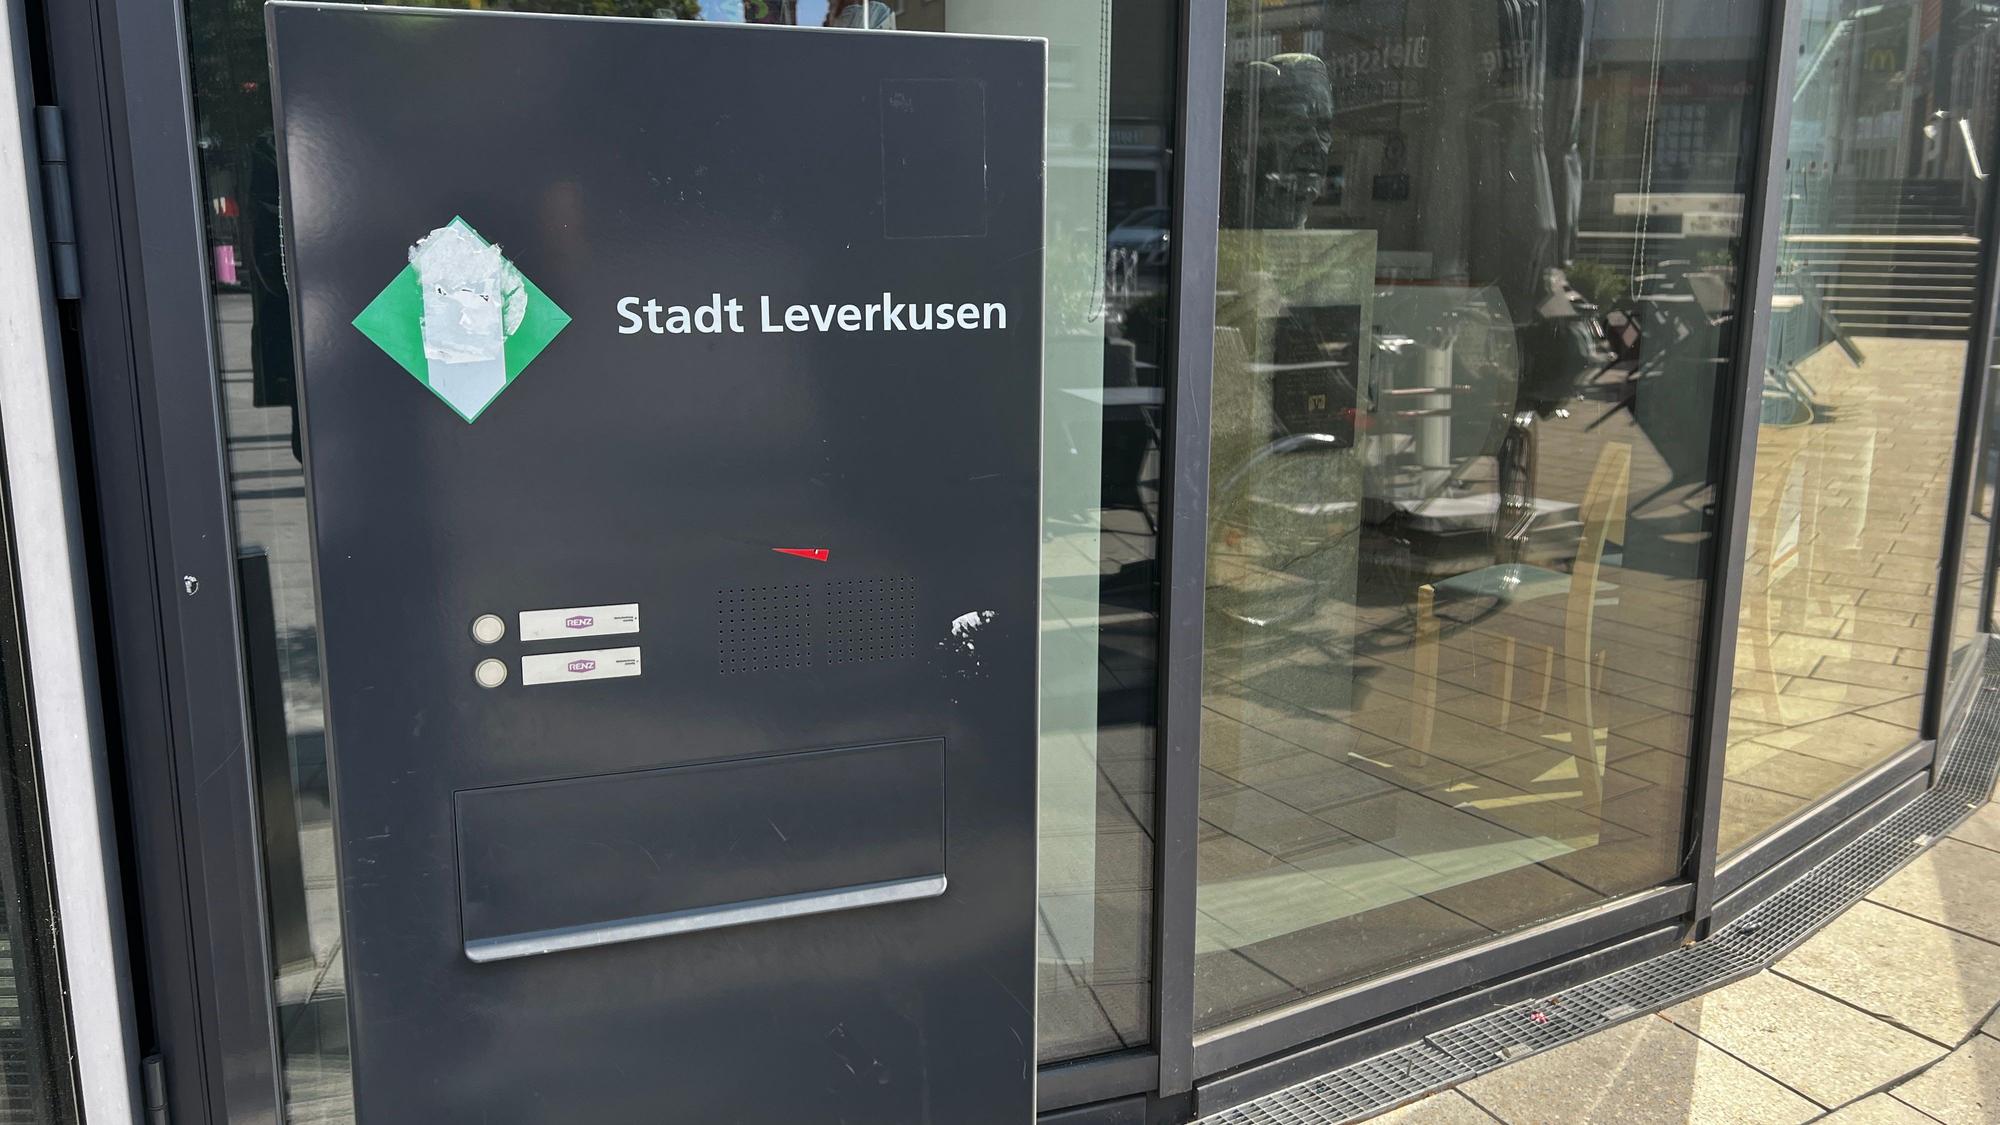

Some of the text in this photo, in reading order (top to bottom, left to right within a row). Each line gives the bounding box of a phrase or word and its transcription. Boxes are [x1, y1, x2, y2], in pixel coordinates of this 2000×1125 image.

[616, 292, 1007, 335] Stadt Leverkusen
[566, 617, 593, 627] RENZ
[568, 661, 595, 671] RENZ
